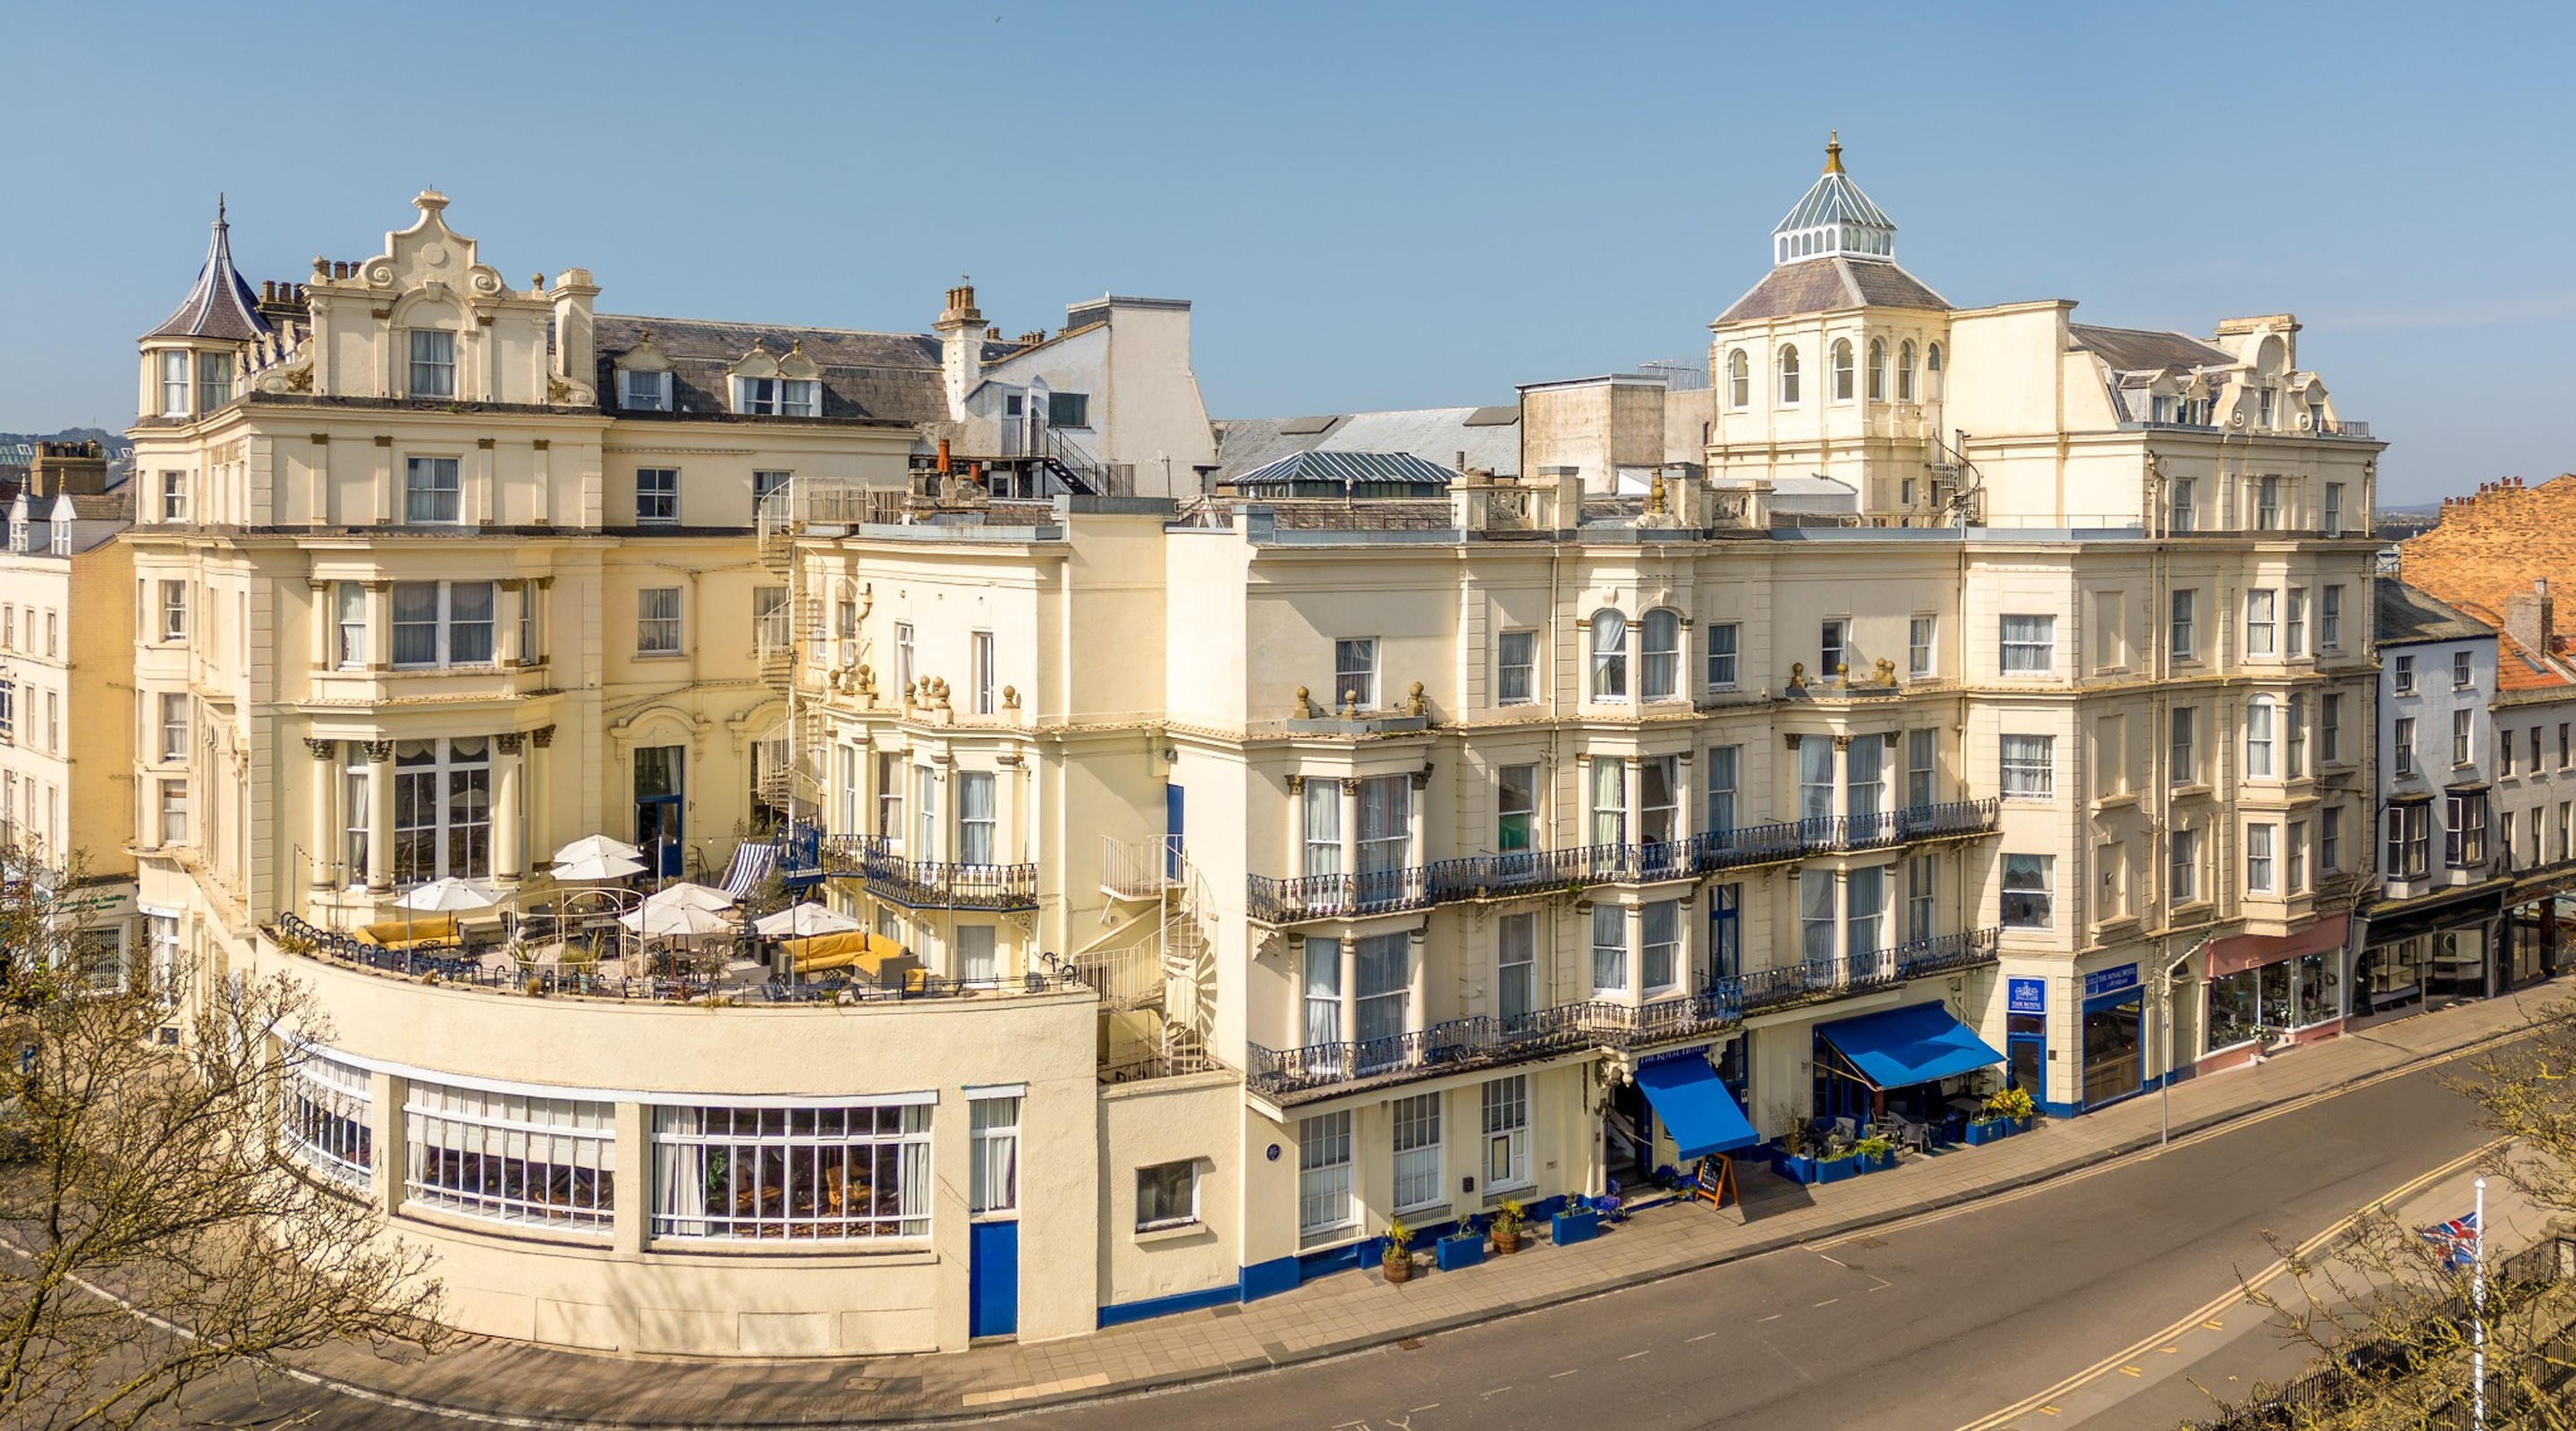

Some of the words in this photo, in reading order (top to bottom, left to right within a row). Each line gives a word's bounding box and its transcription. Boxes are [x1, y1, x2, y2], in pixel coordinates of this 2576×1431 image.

[2107, 970, 2122, 980] ROYAL
[1640, 1056, 1656, 1064] THE
[1657, 1051, 1681, 1061] ROYAL
[1682, 1046, 1707, 1055] HOTEL
